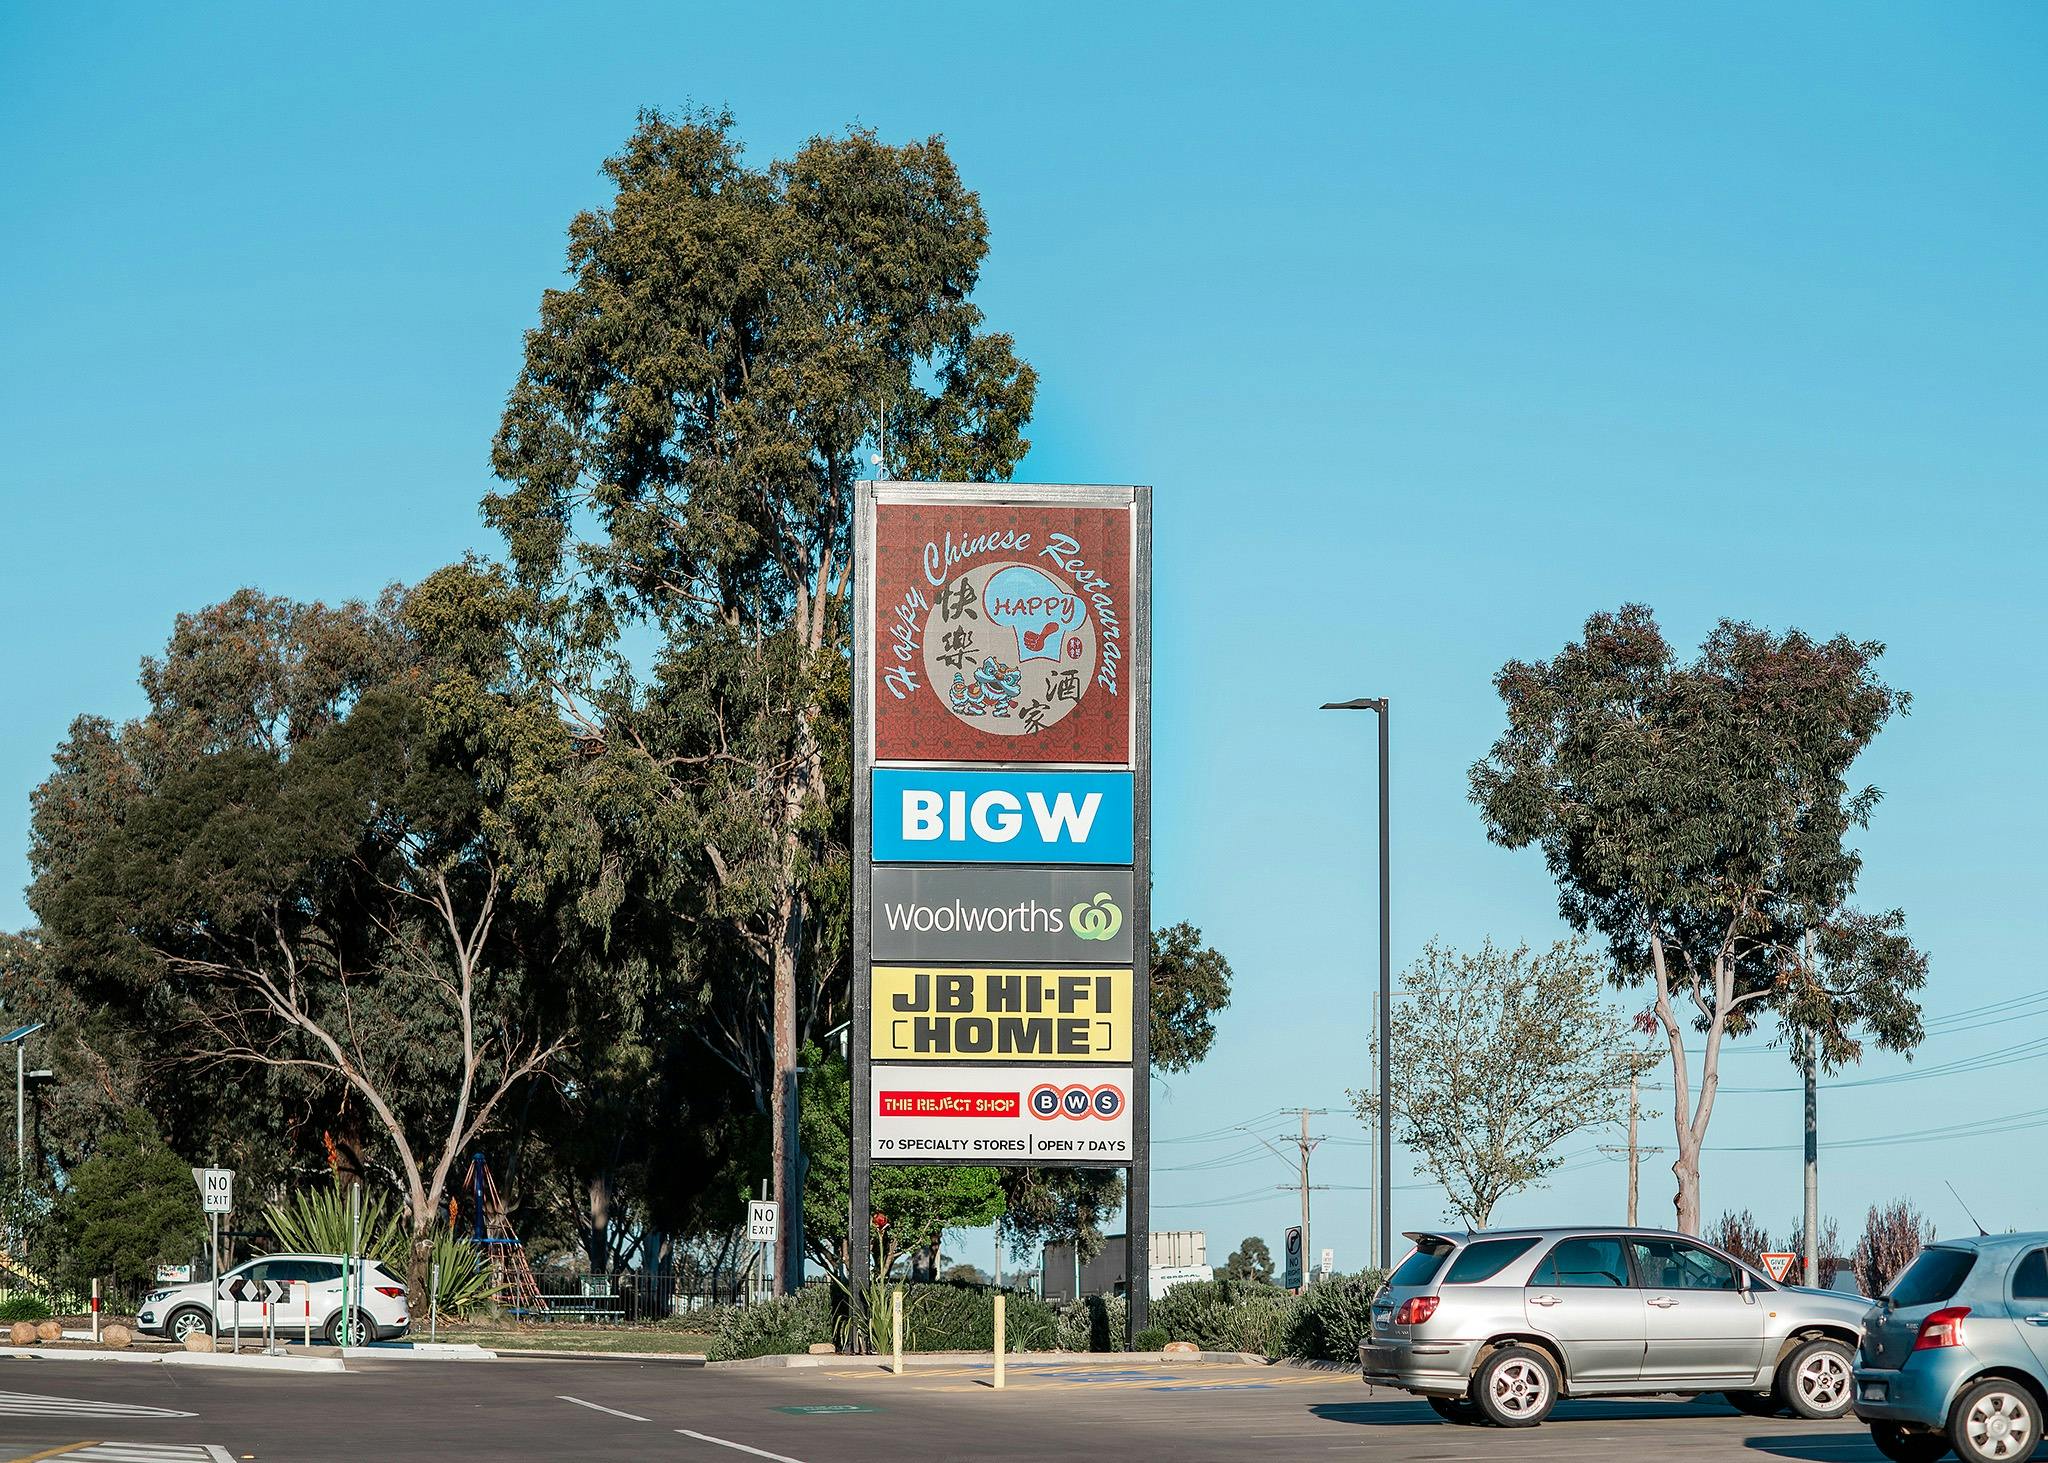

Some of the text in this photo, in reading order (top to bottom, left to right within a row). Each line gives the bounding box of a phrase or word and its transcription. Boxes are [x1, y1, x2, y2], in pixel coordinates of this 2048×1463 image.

[884, 529, 1122, 699] Happy Chinese Restaurant
[993, 596, 1076, 624] HAPPY
[884, 898, 1064, 933] Woolworths
[892, 974, 974, 1013] JB
[885, 1096, 1015, 1112] THE REJECT SHOP
[1040, 1095, 1113, 1110] BWS
[878, 1138, 1126, 1152] 70 SPECIALTY STORES OPEN 7 DAYS
[208, 1176, 228, 1190] NO
[207, 1194, 228, 1205] EXIT
[754, 1208, 774, 1221] NO
[752, 1225, 774, 1235] EXIT
[1289, 1257, 1299, 1267] NO
